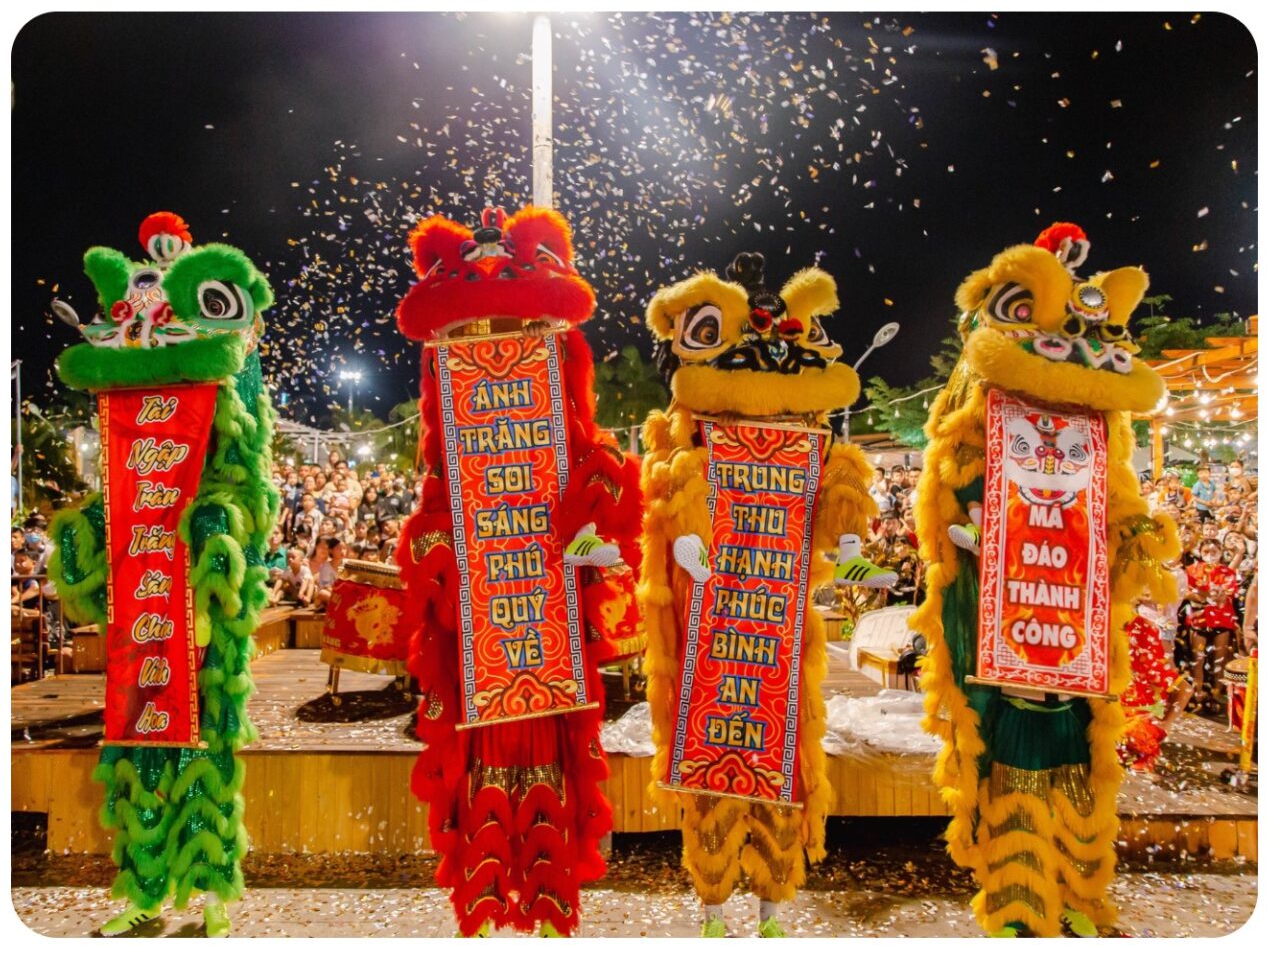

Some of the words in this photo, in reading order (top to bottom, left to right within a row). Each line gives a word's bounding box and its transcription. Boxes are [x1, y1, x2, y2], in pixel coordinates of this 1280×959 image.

[136, 395, 178, 425] Tài
[472, 379, 534, 413] ÁNH
[458, 417, 552, 455] TRĂNG
[126, 437, 189, 475] Ngập
[485, 462, 534, 495] SOI
[714, 462, 808, 495] TRUNG
[133, 480, 180, 513] Tràn
[476, 503, 550, 539] SÁNG
[732, 503, 787, 536] THU
[486, 542, 546, 582] PHÚ
[715, 545, 796, 583] HẠNH
[1022, 541, 1068, 569] ĐÁO
[134, 569, 172, 603] Sán
[1007, 579, 1080, 610] THÀNH
[490, 586, 547, 630] QUÝ
[712, 585, 787, 625] PHÚC
[501, 627, 543, 669] VỀ
[709, 626, 780, 667] BÌNH
[1012, 618, 1076, 649] CÔNG
[717, 675, 762, 707] AN
[705, 711, 766, 752] ĐẾN
